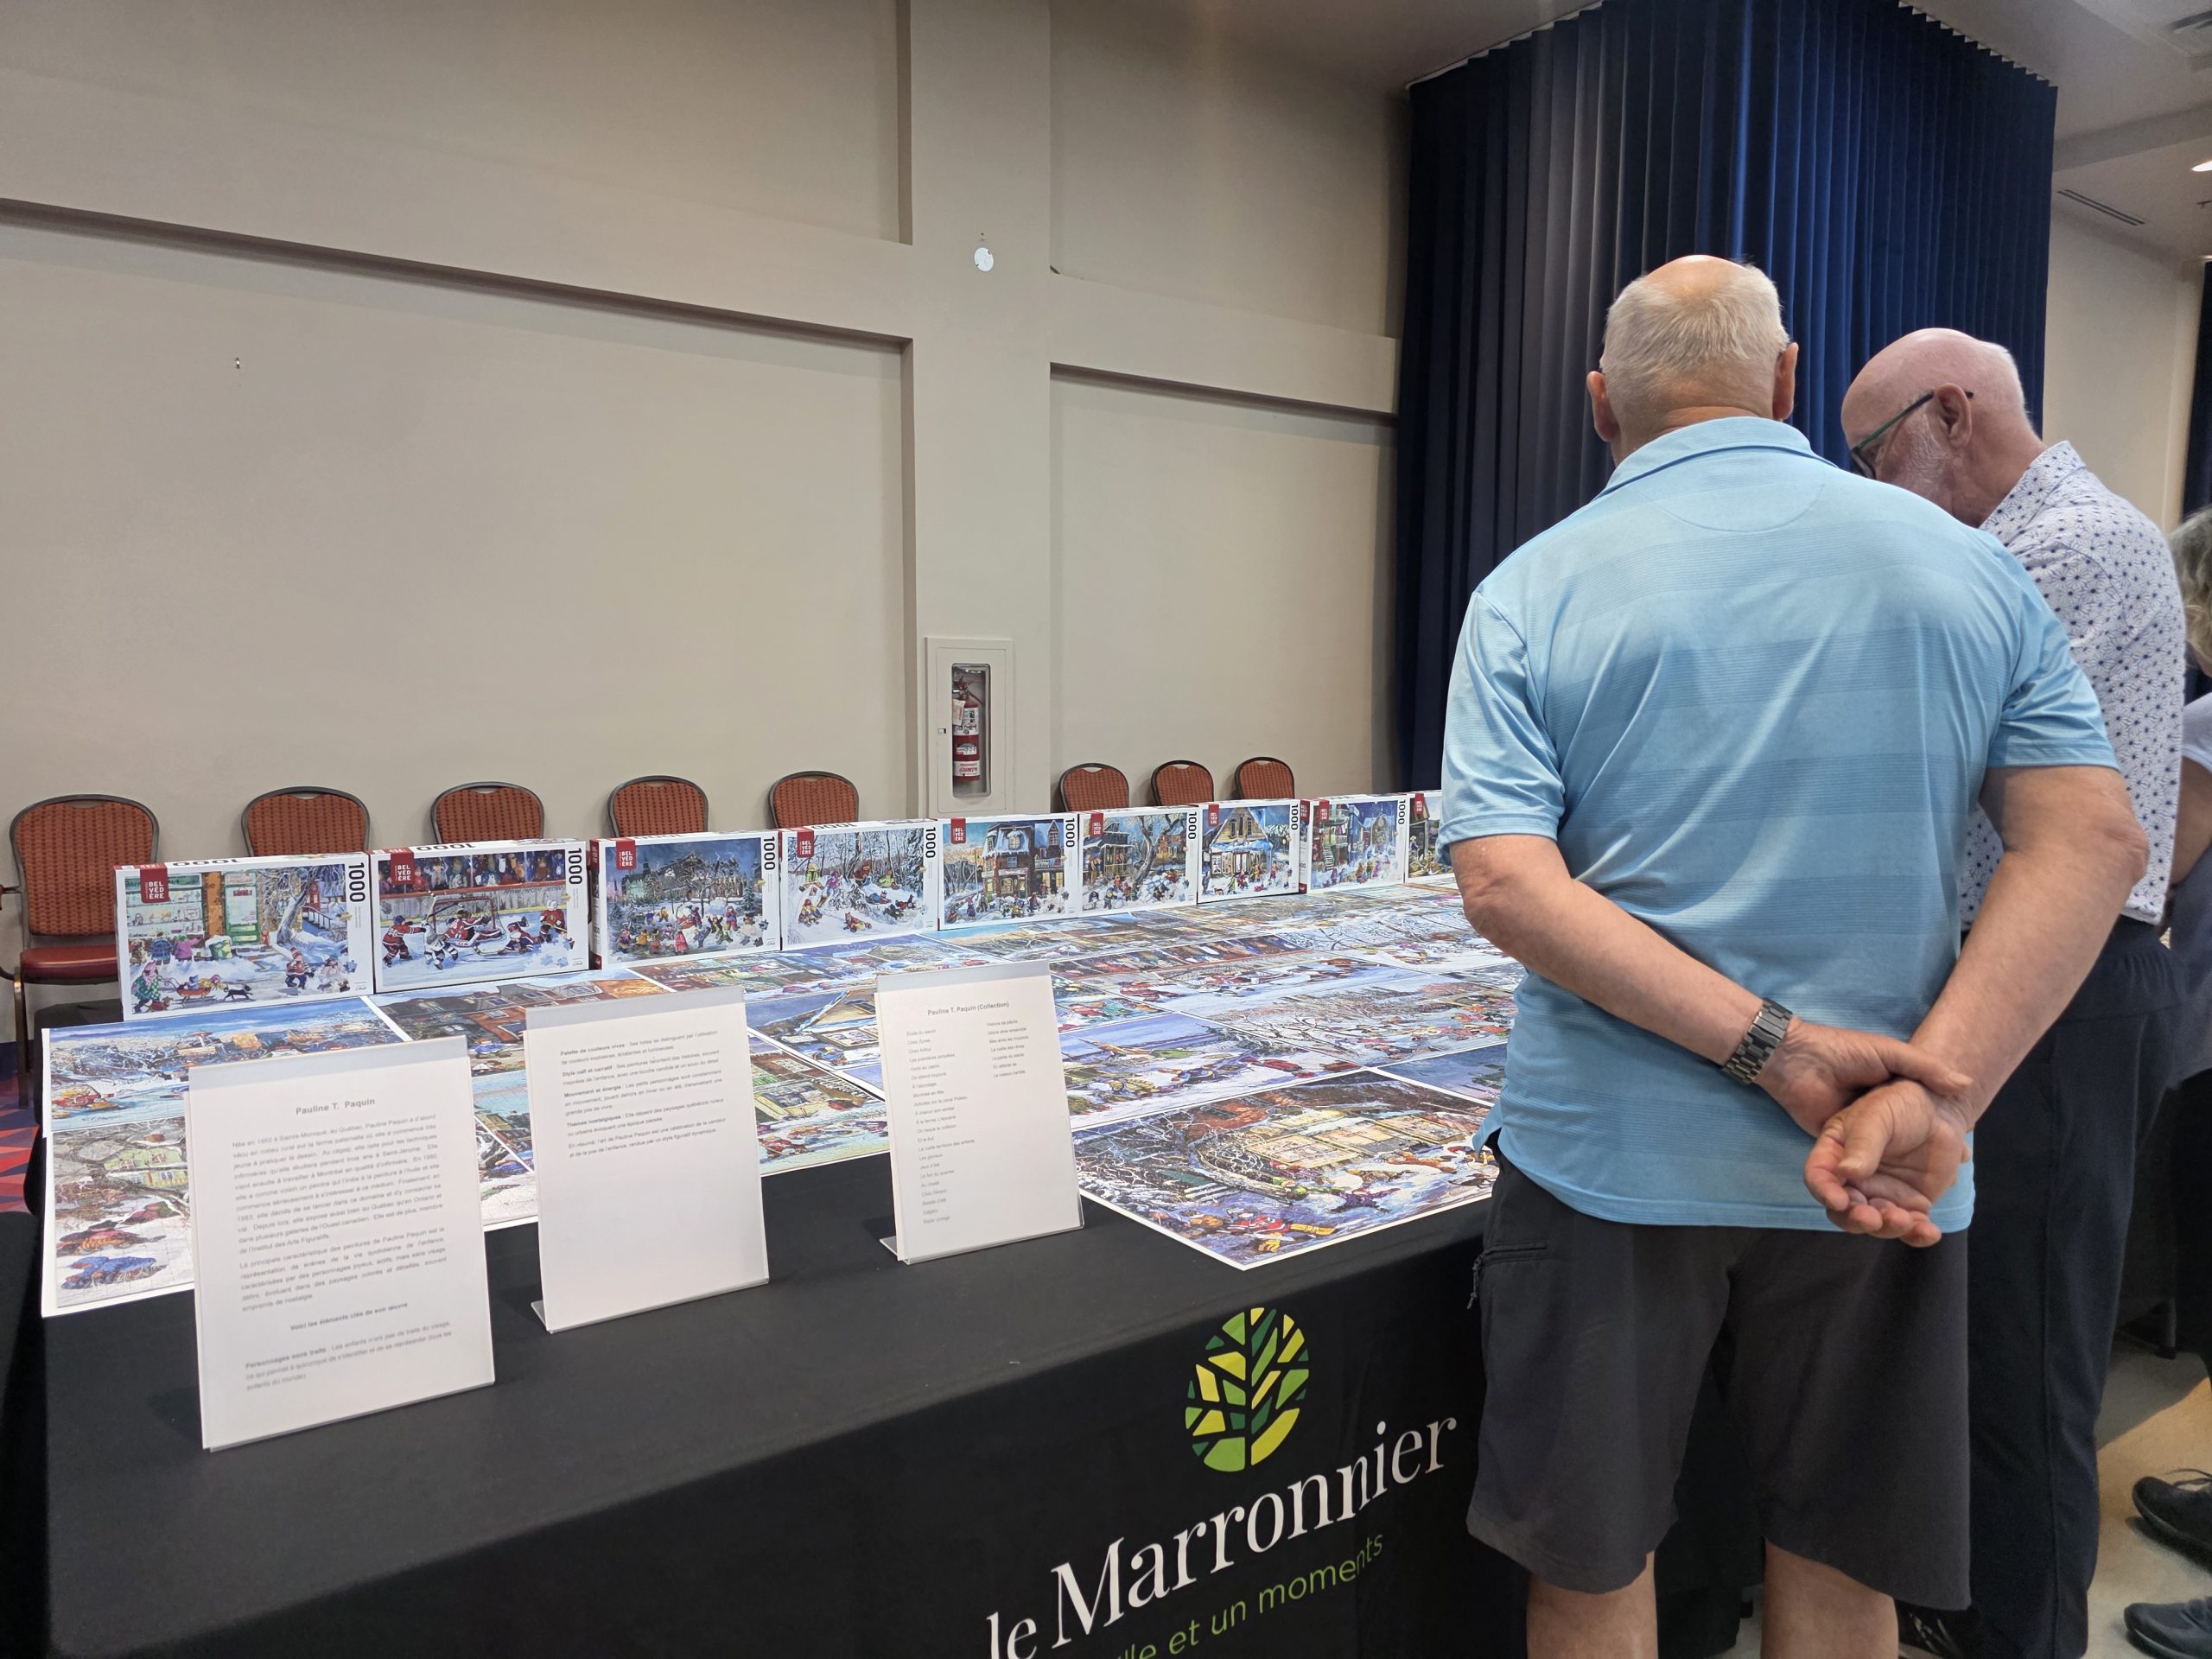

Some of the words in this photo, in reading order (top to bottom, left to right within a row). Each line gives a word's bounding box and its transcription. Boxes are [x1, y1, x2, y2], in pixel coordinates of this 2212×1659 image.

[1065, 818, 1075, 847] 1000
[1188, 812, 1197, 839] 1000
[764, 836, 775, 870] 1000
[925, 827, 936, 858] 1000
[173, 857, 241, 866] 1000
[568, 848, 582, 884] 1000
[348, 862, 365, 902] 1000
[977, 1001, 1009, 1011] (Collection)
[296, 1104, 329, 1115] Pauline
[345, 1098, 375, 1109] Paquin
[986, 1611, 1037, 1659] le
[1051, 1417, 1457, 1649] Marronnier
[1169, 1619, 1200, 1655] et
[1211, 1600, 1246, 1635] un
[1259, 1535, 1383, 1614] moments
